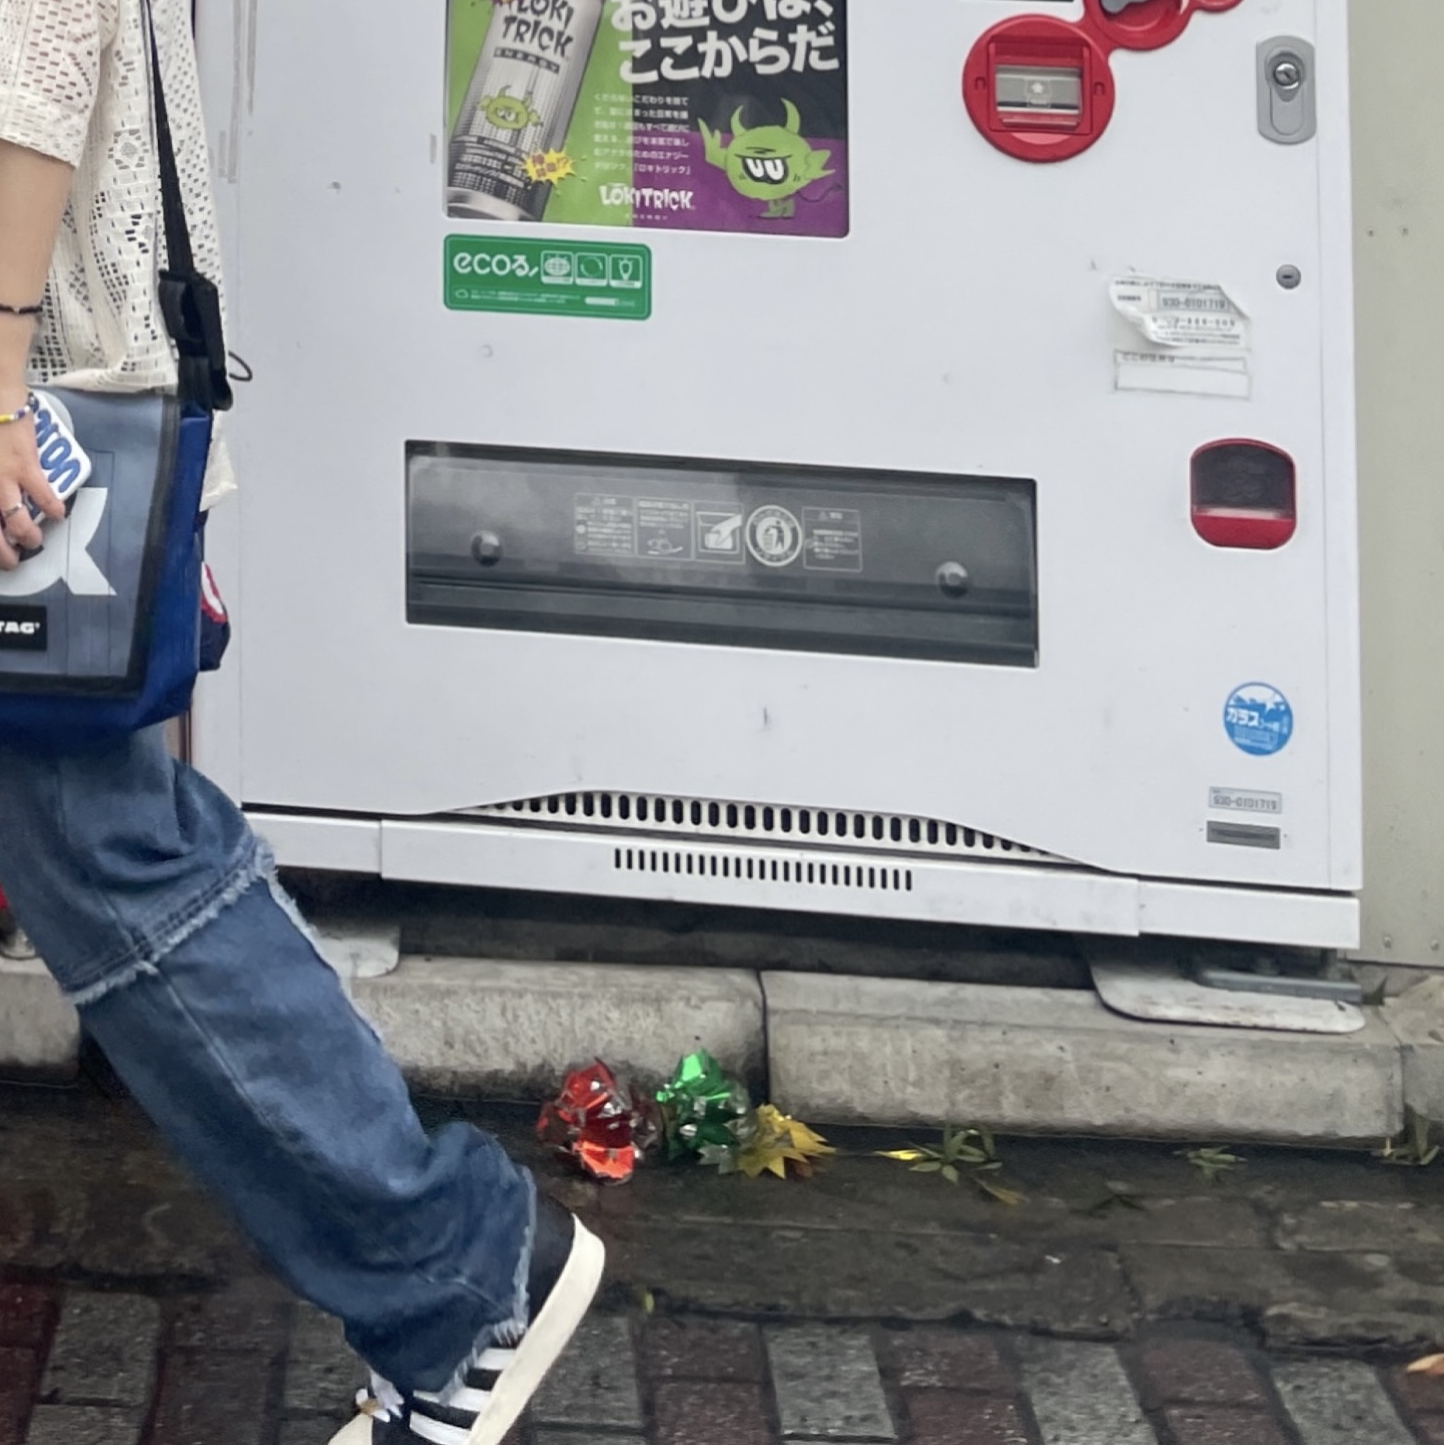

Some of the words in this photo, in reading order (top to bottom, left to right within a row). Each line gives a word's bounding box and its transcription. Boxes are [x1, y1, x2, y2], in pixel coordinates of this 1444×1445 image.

[502, 15, 575, 59] TRICK
[617, 21, 841, 85] ここからだ
